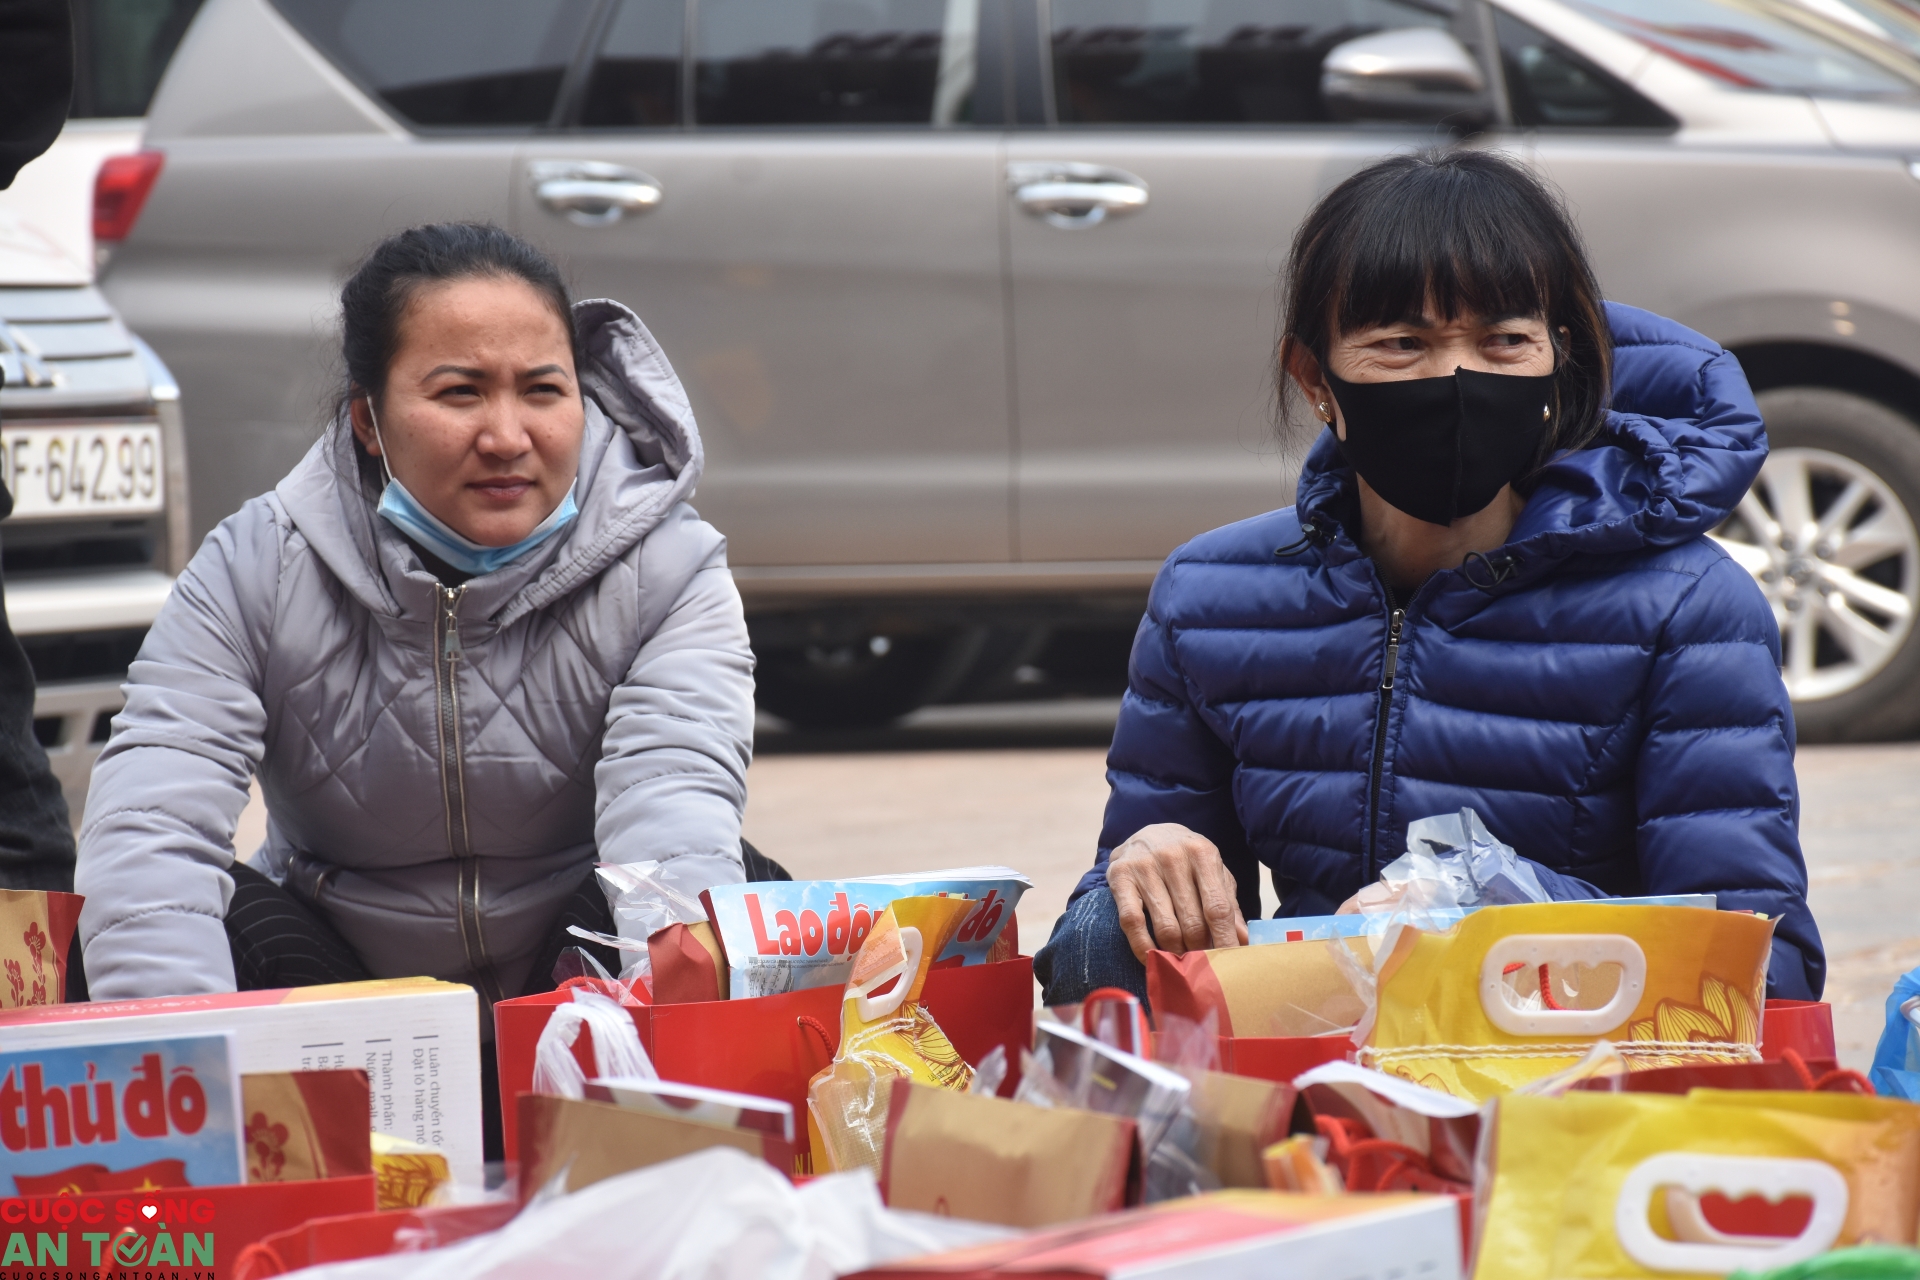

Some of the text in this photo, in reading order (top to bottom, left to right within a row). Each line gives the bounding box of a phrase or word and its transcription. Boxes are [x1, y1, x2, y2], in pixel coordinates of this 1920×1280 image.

[743, 889, 1006, 962] Lao độ đô
[382, 1050, 393, 1090] Thành
[412, 1048, 424, 1070] Đặt
[429, 1047, 440, 1077] Luân
[414, 1073, 425, 1085] lô
[0, 1052, 207, 1153] thủ đô
[412, 1089, 426, 1121] hàng
